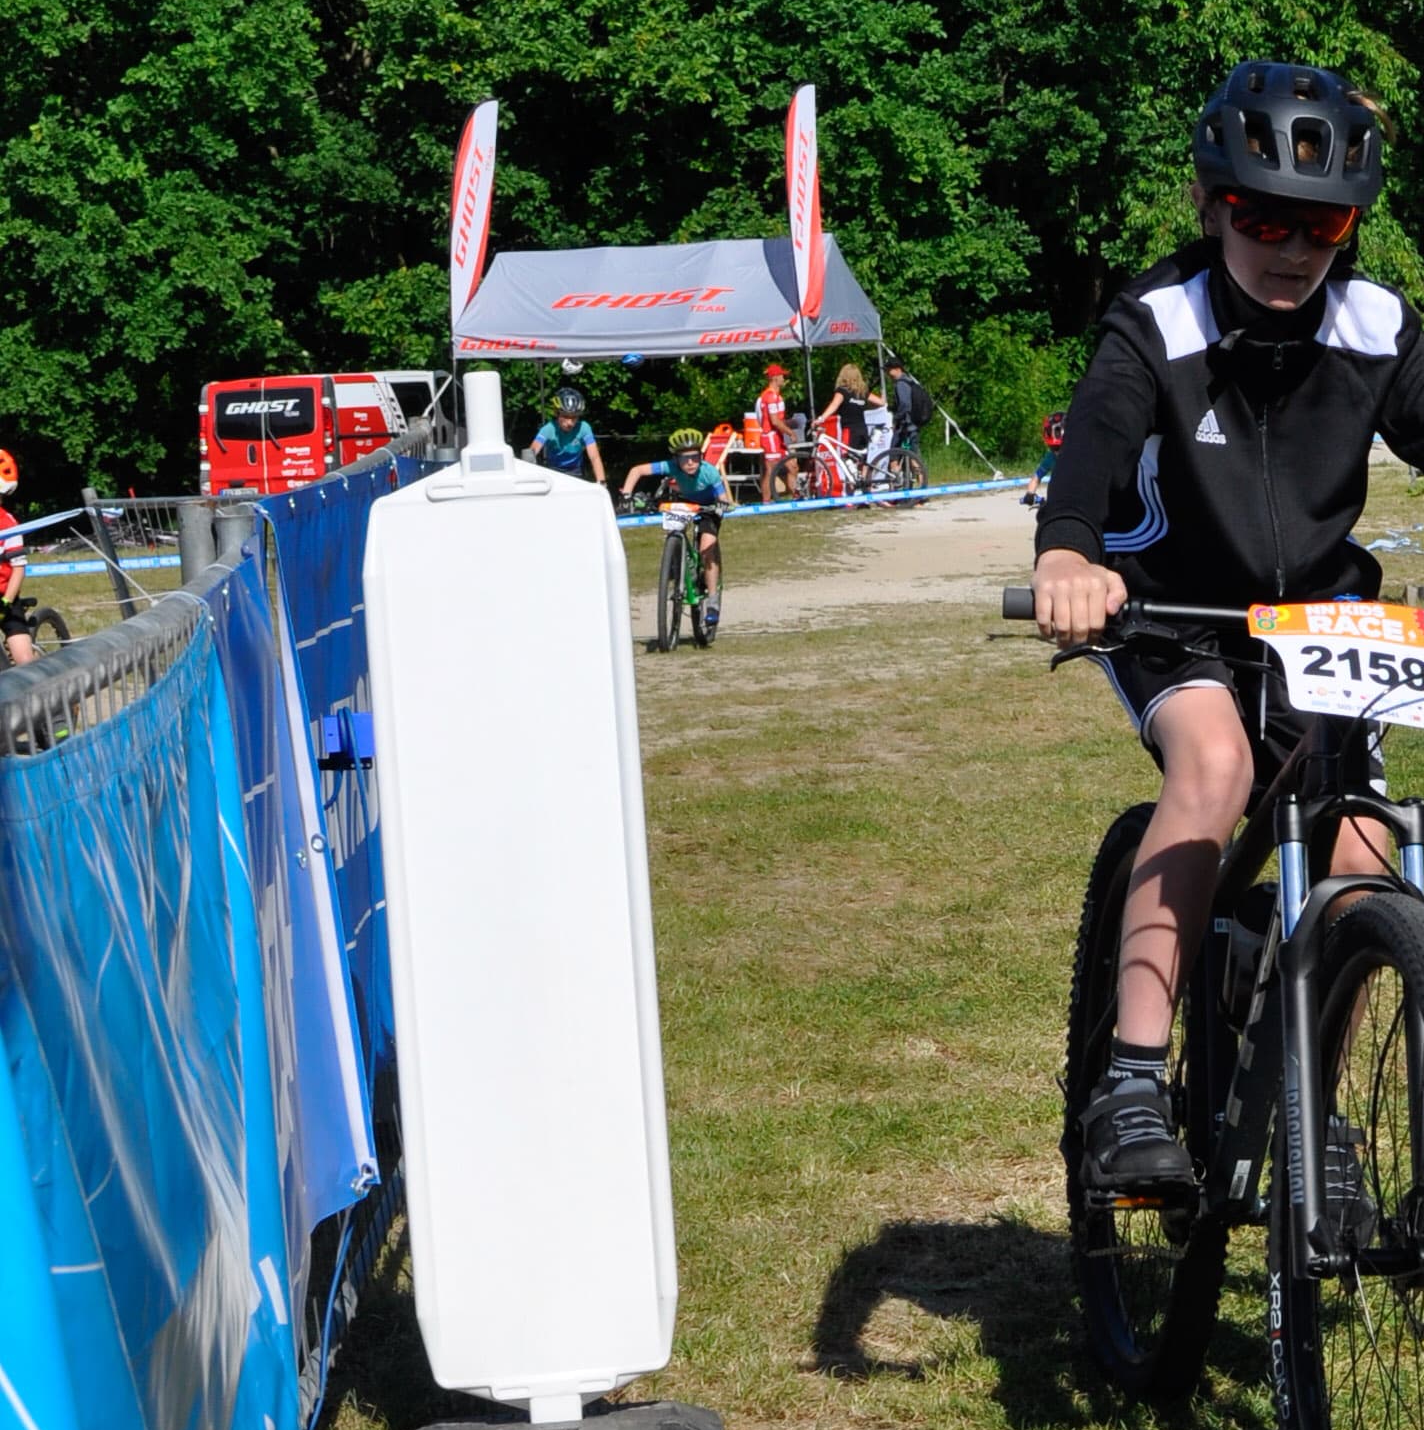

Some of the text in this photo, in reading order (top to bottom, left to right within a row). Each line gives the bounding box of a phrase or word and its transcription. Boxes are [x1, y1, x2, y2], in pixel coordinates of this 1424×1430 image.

[552, 286, 735, 310] GHOST
[688, 304, 726, 313] TEAM
[460, 337, 540, 351] GHOST
[698, 327, 785, 345] GHOST
[225, 398, 300, 416] GHOST
[1194, 430, 1227, 445] adidas
[1304, 604, 1386, 618] NN KIDS
[1306, 615, 1406, 643] RACE
[1269, 1271, 1282, 1330] XR2
